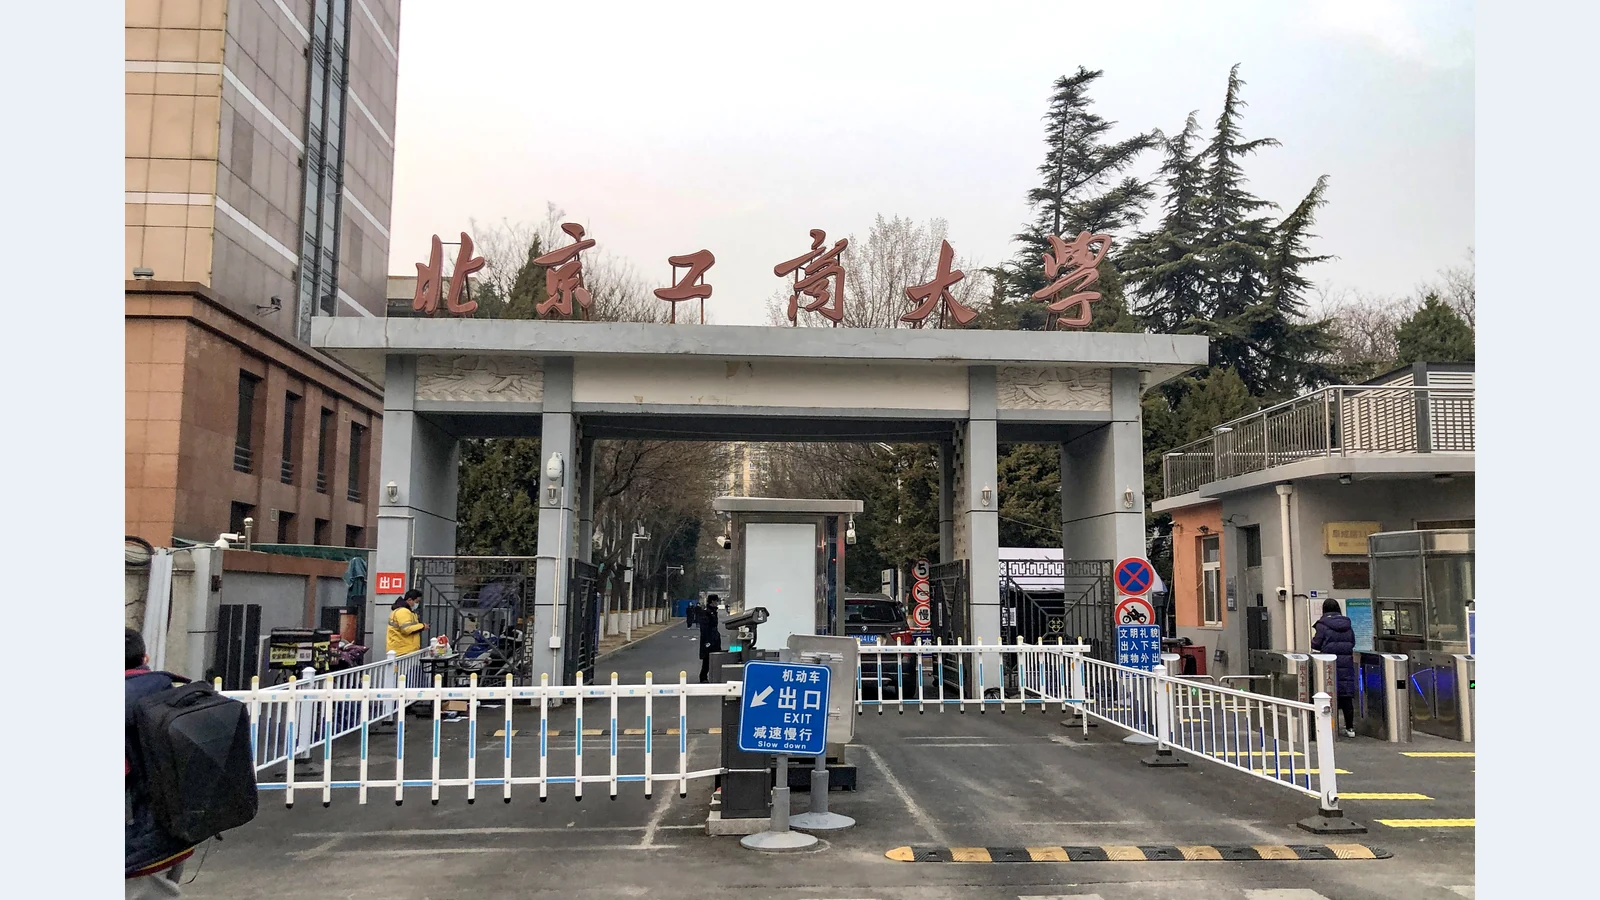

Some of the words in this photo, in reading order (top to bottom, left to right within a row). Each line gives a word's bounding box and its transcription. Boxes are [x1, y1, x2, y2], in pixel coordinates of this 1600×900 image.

[918, 564, 927, 576] 5
[380, 576, 402, 589] 出口
[919, 609, 930, 621] 慢
[1120, 628, 1159, 639] 文明礼貌
[1121, 640, 1159, 651] 出入下车
[1120, 653, 1159, 664] 携物外出
[782, 669, 821, 684] 机动车
[777, 686, 821, 710] 出口
[783, 713, 812, 724] EXIT
[753, 726, 812, 742] 减速慢行
[784, 742, 806, 750] down
